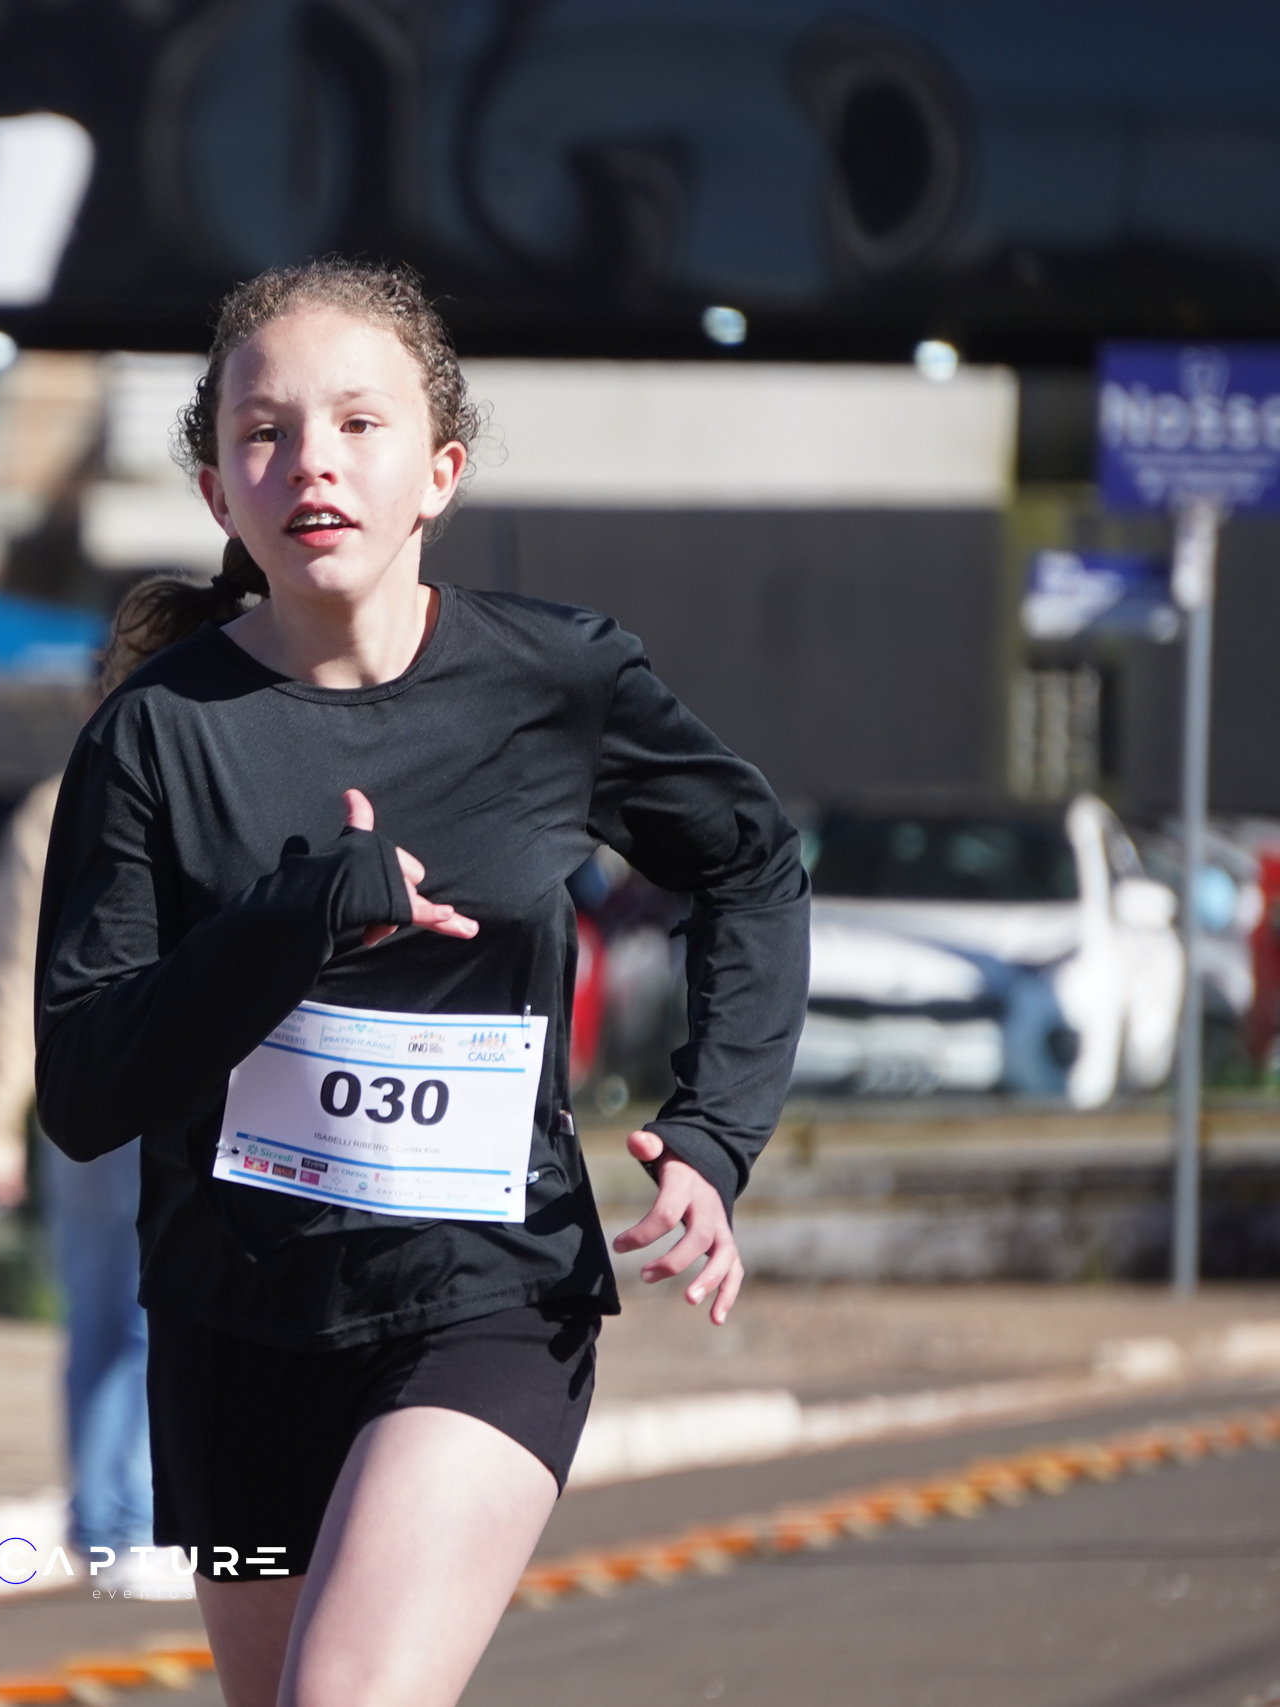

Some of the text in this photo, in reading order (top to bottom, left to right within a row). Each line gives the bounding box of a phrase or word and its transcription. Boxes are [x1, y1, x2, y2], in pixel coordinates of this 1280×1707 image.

[323, 1035, 392, 1051] PRATIQUE AJUDA
[467, 1051, 506, 1062] CAUSA
[320, 1070, 450, 1126] 030
[314, 1131, 352, 1147] ISABELLI
[353, 1139, 389, 1153] RIBEIRO
[260, 1147, 294, 1164] Sicredi
[341, 1168, 369, 1180] CRESOL
